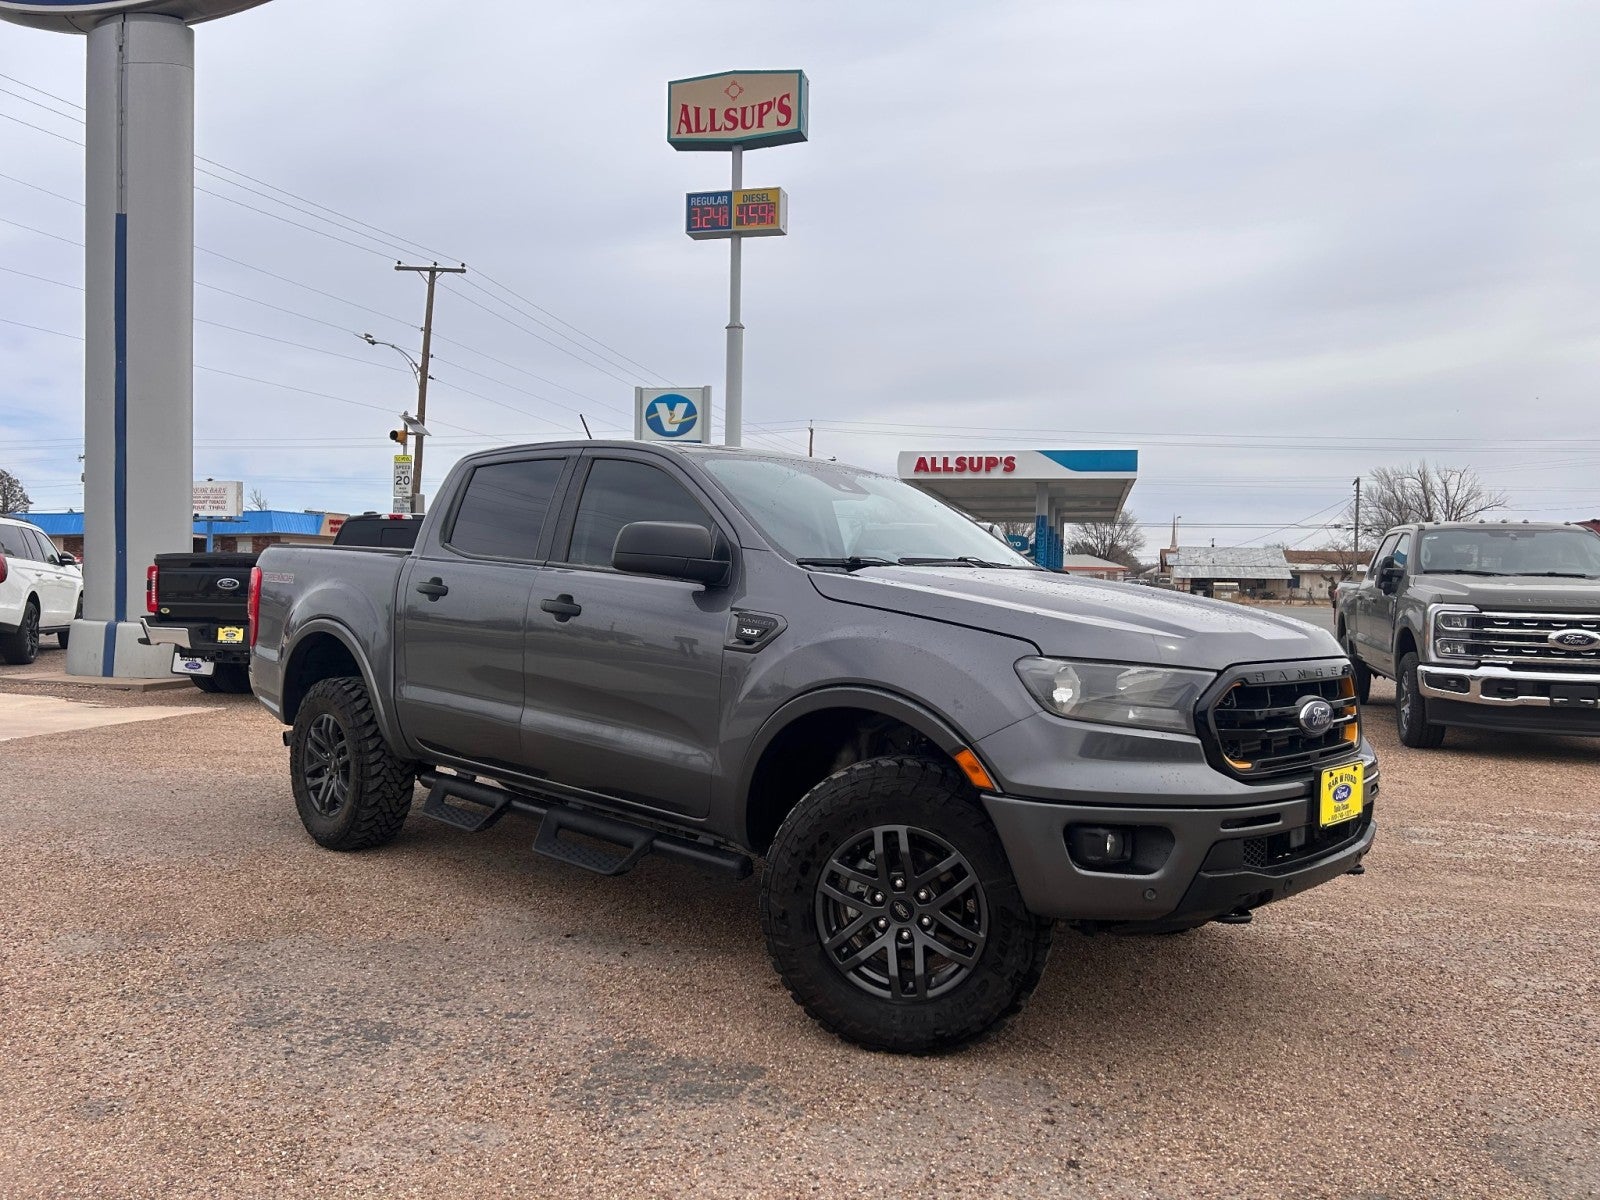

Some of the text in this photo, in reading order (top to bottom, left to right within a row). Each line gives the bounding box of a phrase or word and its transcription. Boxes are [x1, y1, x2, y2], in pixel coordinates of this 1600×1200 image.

[676, 93, 792, 135] ALLSUP'S
[691, 193, 771, 206] REGULAR DIESEL
[914, 456, 1016, 473] ALLSUP'S
[395, 475, 410, 486] 20
[740, 617, 775, 627] RANGER
[741, 627, 761, 636] XLT
[1563, 634, 1590, 646] Ford
[1255, 666, 1342, 682] RANGE
[1311, 706, 1331, 726] Ford
[1344, 773, 1357, 785] FORD
[1335, 785, 1349, 800] Ford
